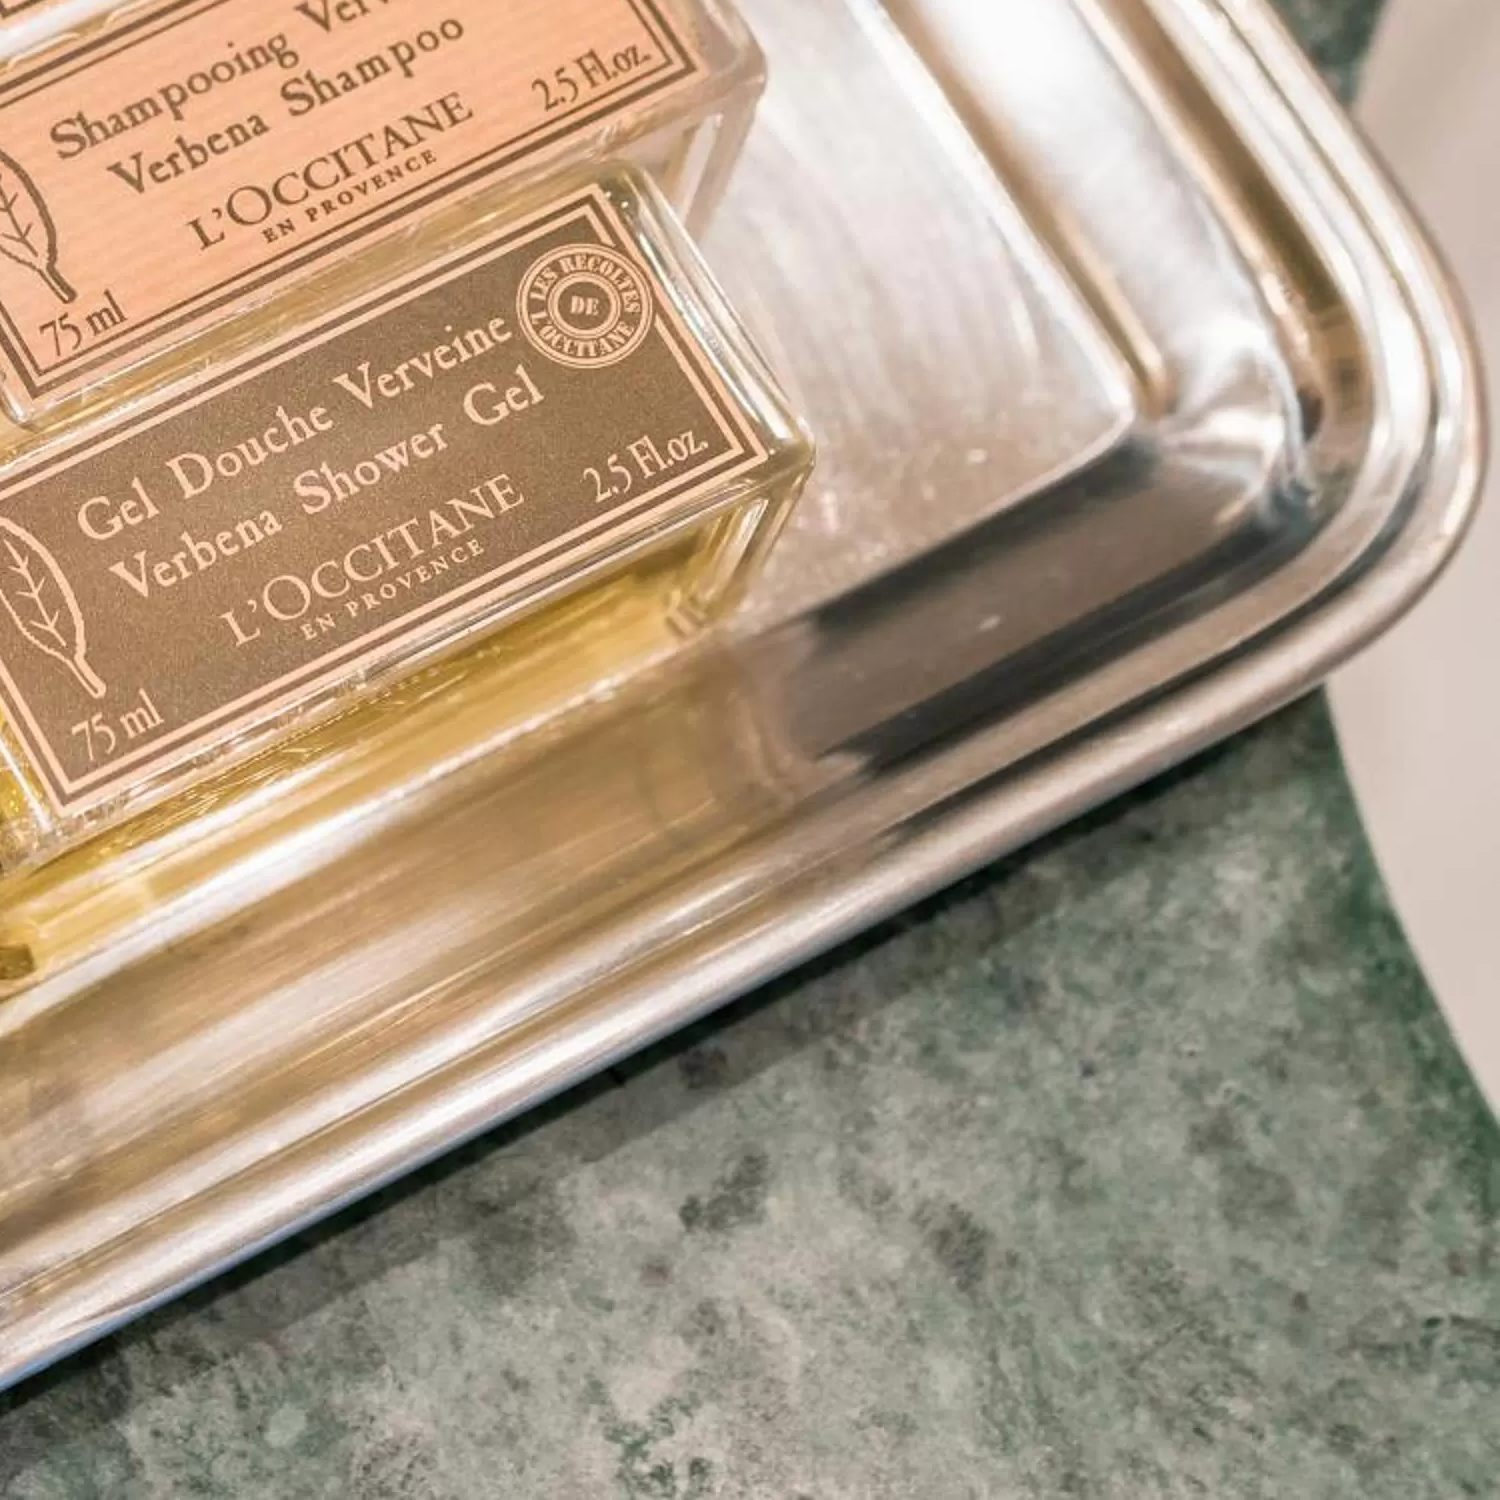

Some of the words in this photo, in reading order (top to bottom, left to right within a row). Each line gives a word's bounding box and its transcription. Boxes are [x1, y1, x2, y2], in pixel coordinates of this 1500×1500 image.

[49, 32, 300, 160] Shampooing
[107, 112, 271, 197] Verbena
[280, 18, 466, 116] Shampoo
[531, 66, 578, 111] 2.5
[185, 92, 474, 250] L'OCCITANE
[263, 218, 296, 244] EN
[303, 149, 438, 225] PROVENCE
[40, 312, 81, 358] 75
[84, 289, 127, 336] ml
[530, 266, 558, 301] LES
[570, 295, 599, 316] DE
[76, 477, 161, 542] Gel
[167, 406, 334, 502] Douche
[332, 315, 512, 410] Verveine
[108, 510, 282, 600] Verbena
[293, 424, 450, 516] Shower
[463, 364, 546, 427] Gel
[583, 453, 632, 503] 2.5
[221, 474, 526, 647] L'OCCITANE
[300, 612, 336, 640] EN
[346, 538, 486, 618] PROVENCE
[72, 712, 116, 763] 75
[117, 688, 164, 740] ml
